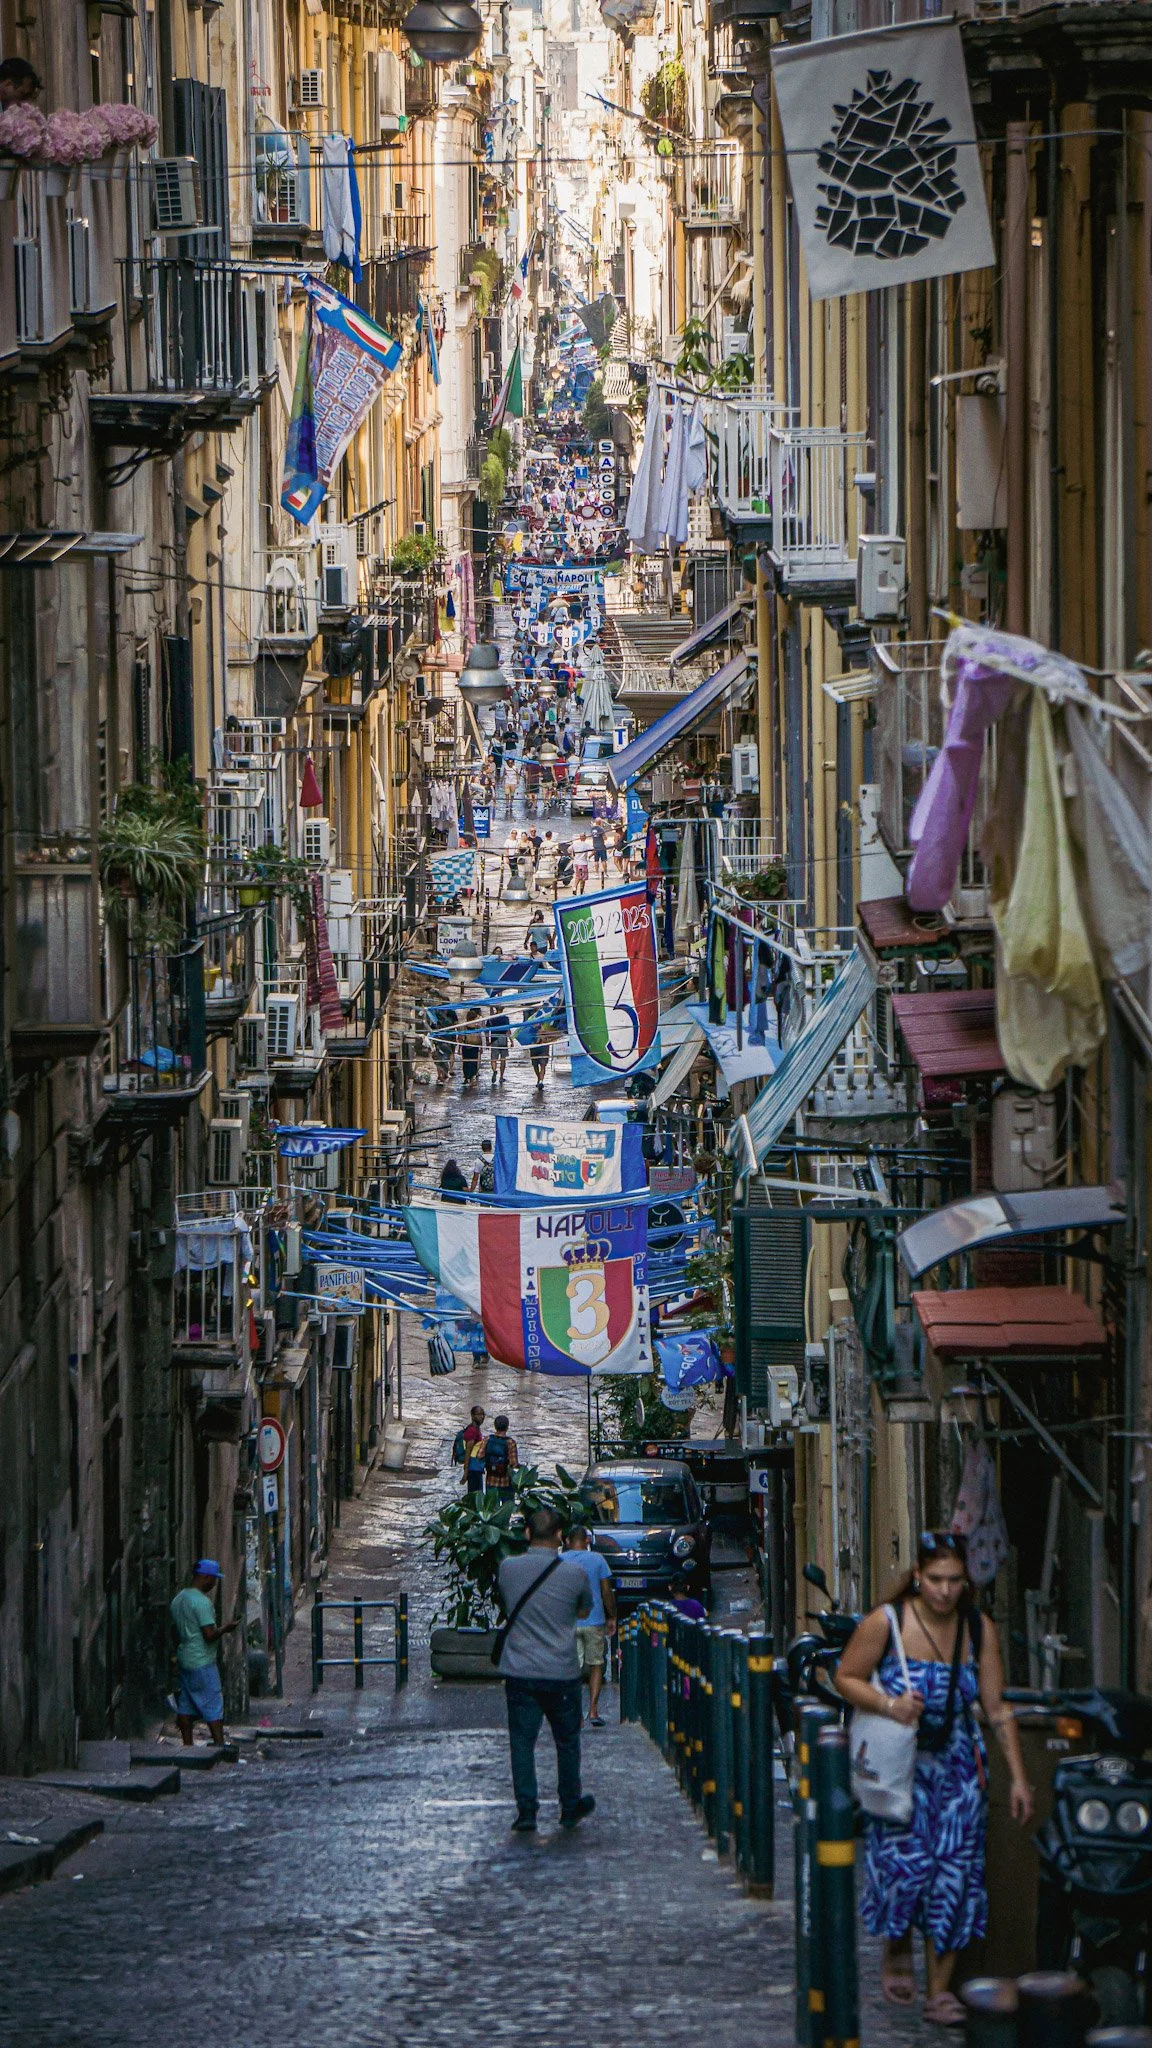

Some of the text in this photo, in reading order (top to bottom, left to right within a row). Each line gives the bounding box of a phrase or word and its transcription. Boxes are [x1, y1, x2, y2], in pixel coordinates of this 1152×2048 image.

[318, 347, 359, 398] NAPOLI
[338, 366, 377, 412] SOGNO
[600, 441, 613, 515] SACCO
[557, 573, 593, 583] NAPOLI
[614, 728, 626, 745] T
[567, 903, 650, 947] 2022/2023
[601, 959, 640, 1060] 3
[536, 1207, 636, 1239] NAPOLI
[319, 1270, 360, 1289] PANIFICIO
[525, 1266, 541, 1370] CAMPIONE
[565, 1272, 611, 1341] 3
